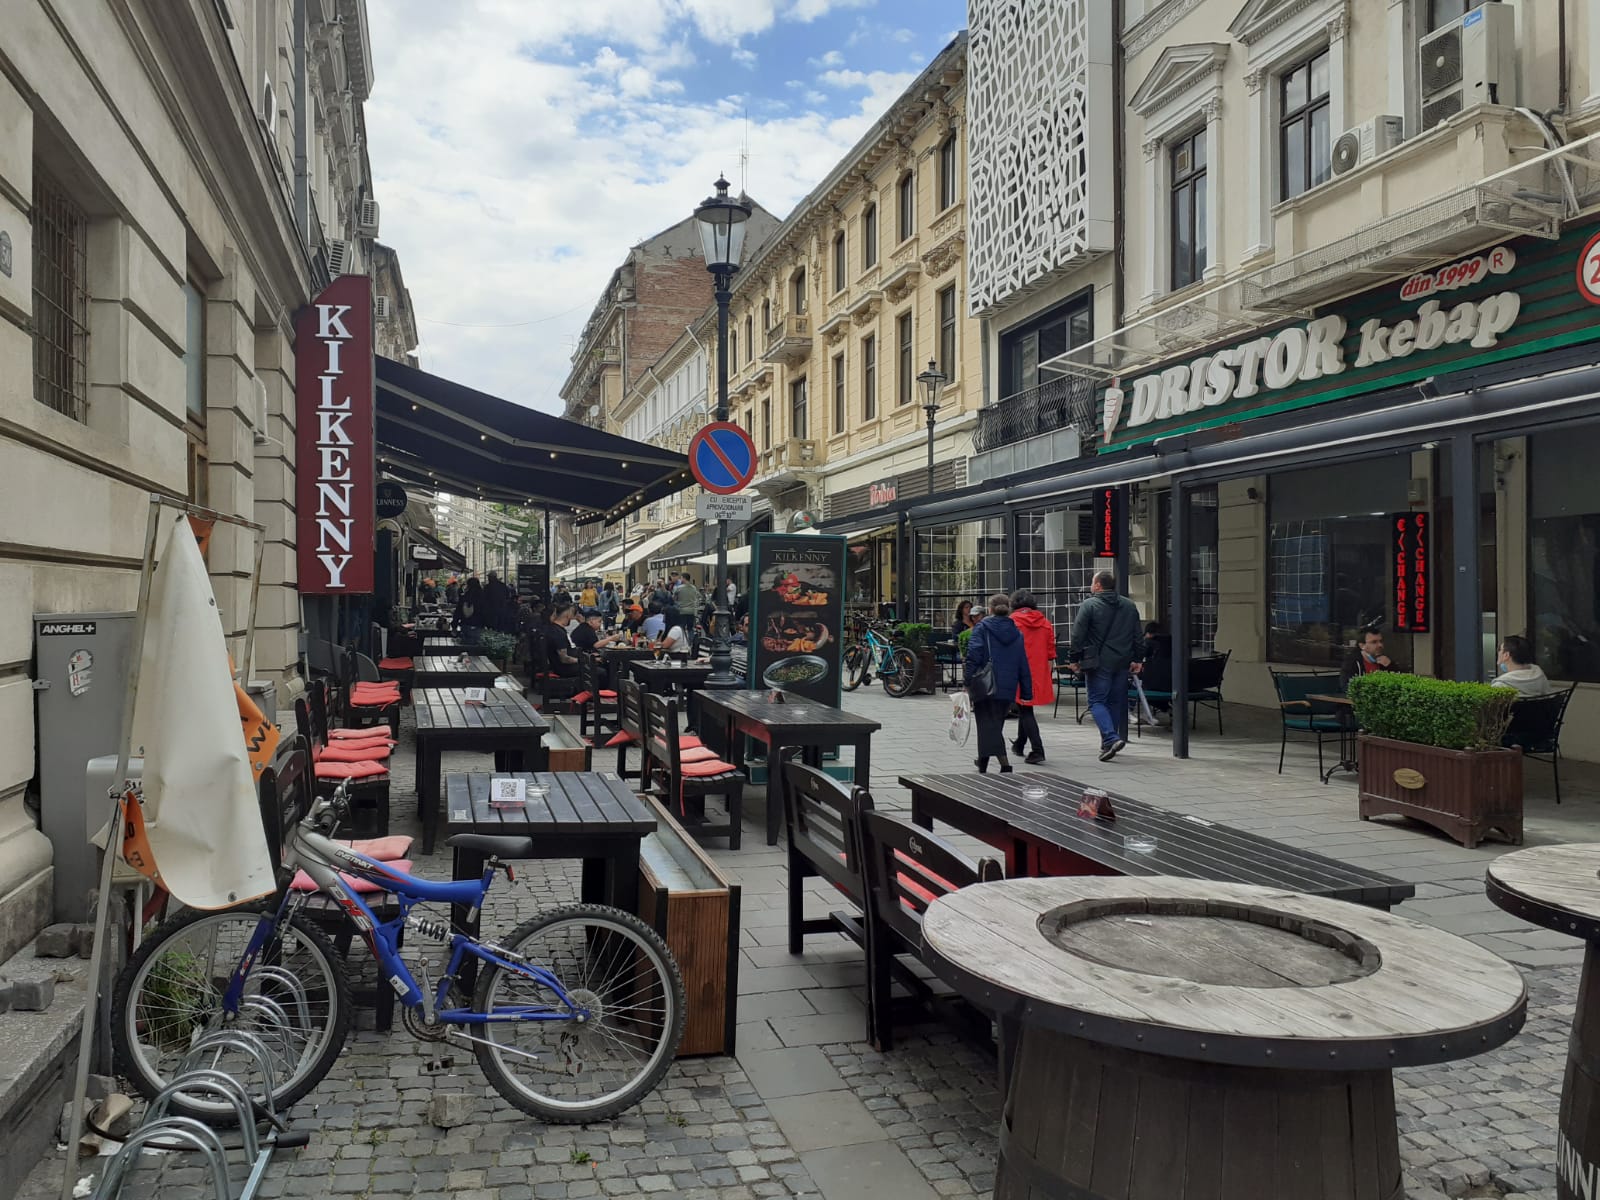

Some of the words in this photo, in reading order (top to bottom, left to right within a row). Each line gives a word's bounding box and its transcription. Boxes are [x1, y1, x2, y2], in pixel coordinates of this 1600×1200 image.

[1402, 276, 1432, 298] din
[1435, 259, 1481, 287] 1999
[1127, 314, 1348, 427] DRISTOR
[1354, 291, 1521, 368] kebap
[314, 303, 355, 588] KILKENNY
[376, 498, 405, 507] UINNESS
[775, 552, 828, 562] KILKENNY
